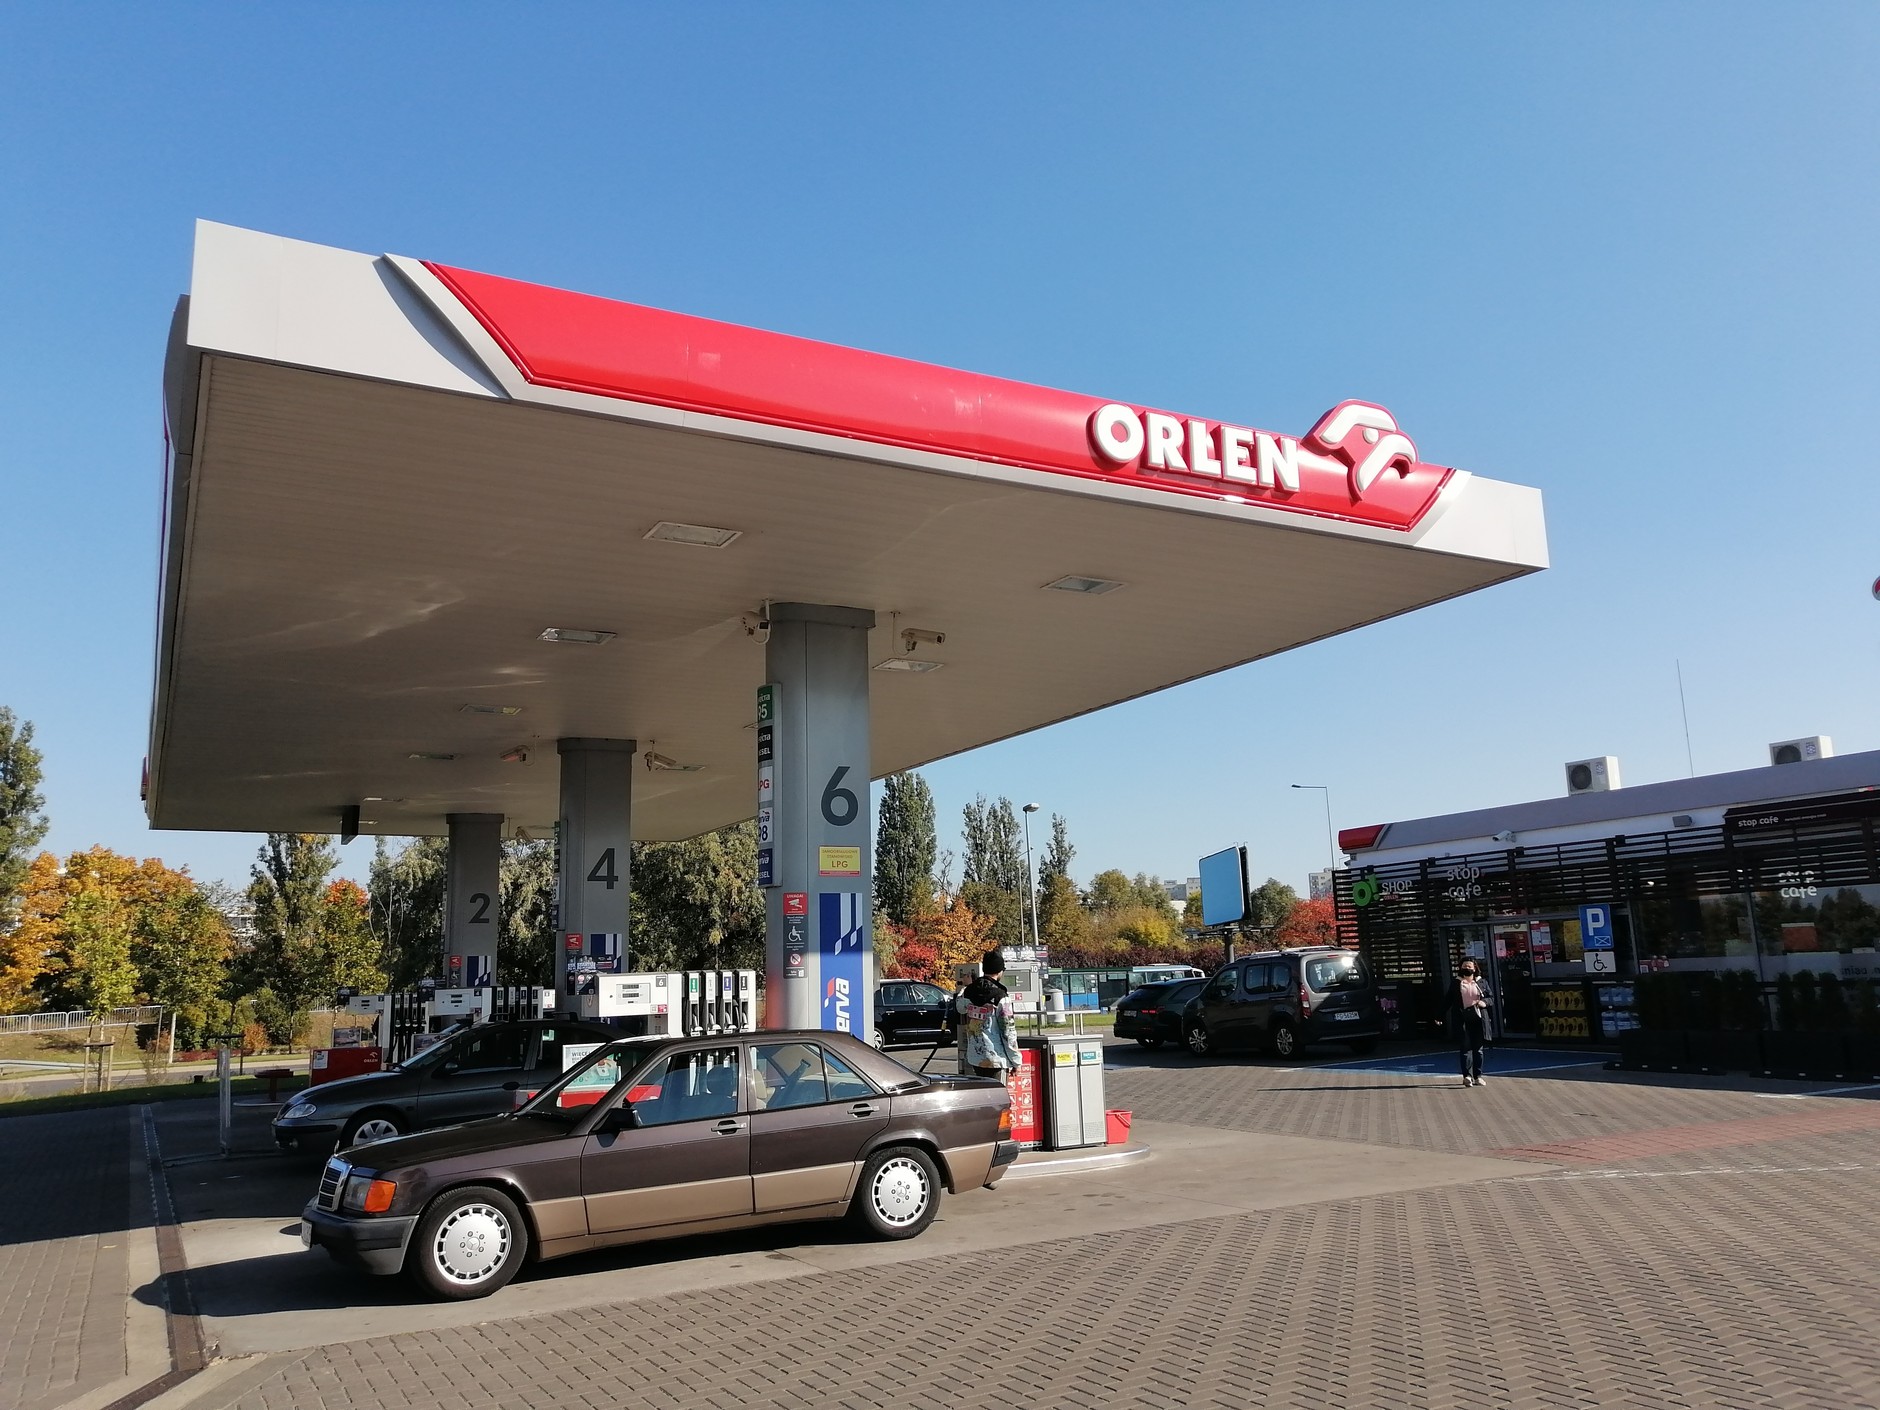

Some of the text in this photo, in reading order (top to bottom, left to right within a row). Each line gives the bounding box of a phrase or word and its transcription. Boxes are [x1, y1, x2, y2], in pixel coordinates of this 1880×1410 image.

[1093, 403, 1300, 493] ORLEN
[759, 779, 770, 790] PG
[821, 766, 858, 826] 6
[1738, 818, 1757, 827] stop
[1760, 816, 1779, 825] cafe
[587, 848, 618, 889] 4
[831, 860, 848, 868] LPG
[1447, 866, 1480, 882] stop
[1382, 880, 1412, 893] SHOP
[1449, 882, 1482, 899] cafe
[1781, 885, 1817, 899] cafe
[468, 893, 490, 923] 2
[1587, 908, 1604, 935] P
[835, 977, 850, 1033] erva
